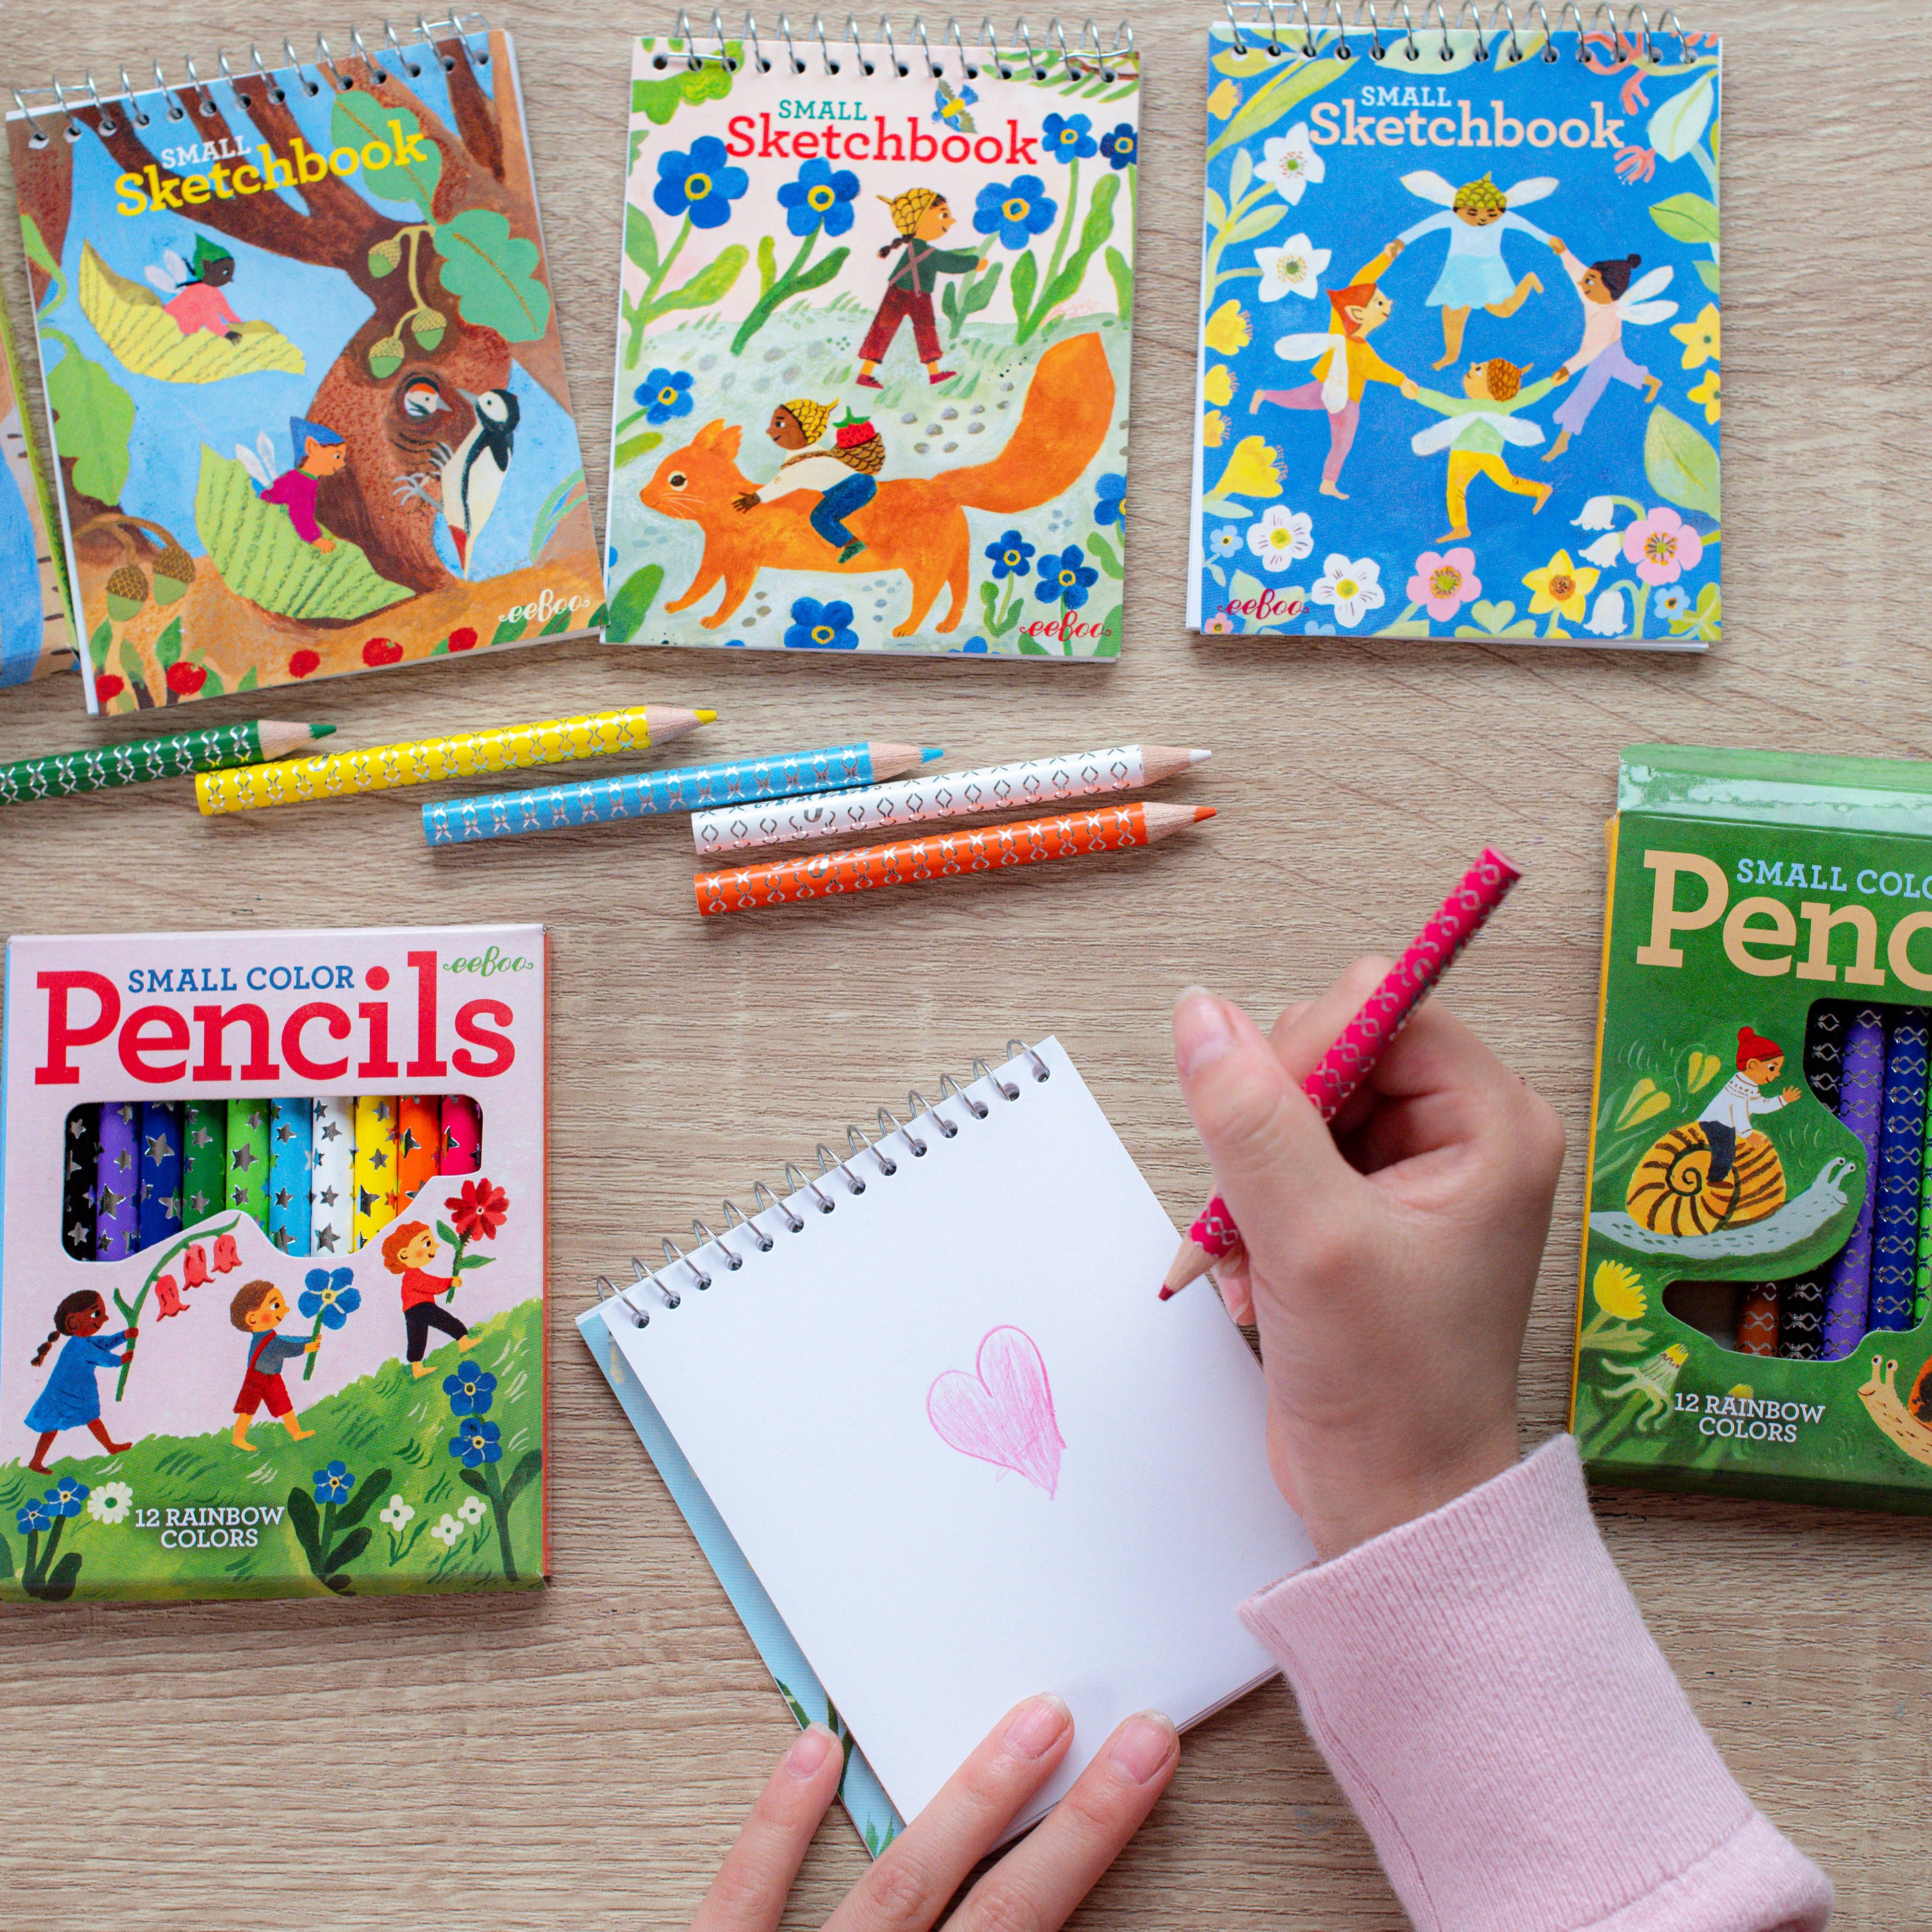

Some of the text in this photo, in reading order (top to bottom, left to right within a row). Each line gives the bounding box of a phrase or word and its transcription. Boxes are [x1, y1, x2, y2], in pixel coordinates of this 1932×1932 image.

[778, 100, 867, 120] SMALL
[1361, 87, 1451, 107] SMALL
[1310, 99, 1624, 148] Sketchbook
[160, 135, 251, 169] SMALL
[726, 113, 1037, 165] Sketchbook
[114, 119, 427, 216] Sketchbook
[1736, 858, 1847, 892] SMALL
[128, 965, 355, 993] SMALL COLOR
[35, 950, 515, 1085] Pencils
[1674, 1393, 1825, 1423] 12 RAINBOW
[1699, 1416, 1797, 1443] COLORS
[135, 1506, 285, 1527] 12 RAINBOW
[160, 1528, 258, 1549] COLORS
